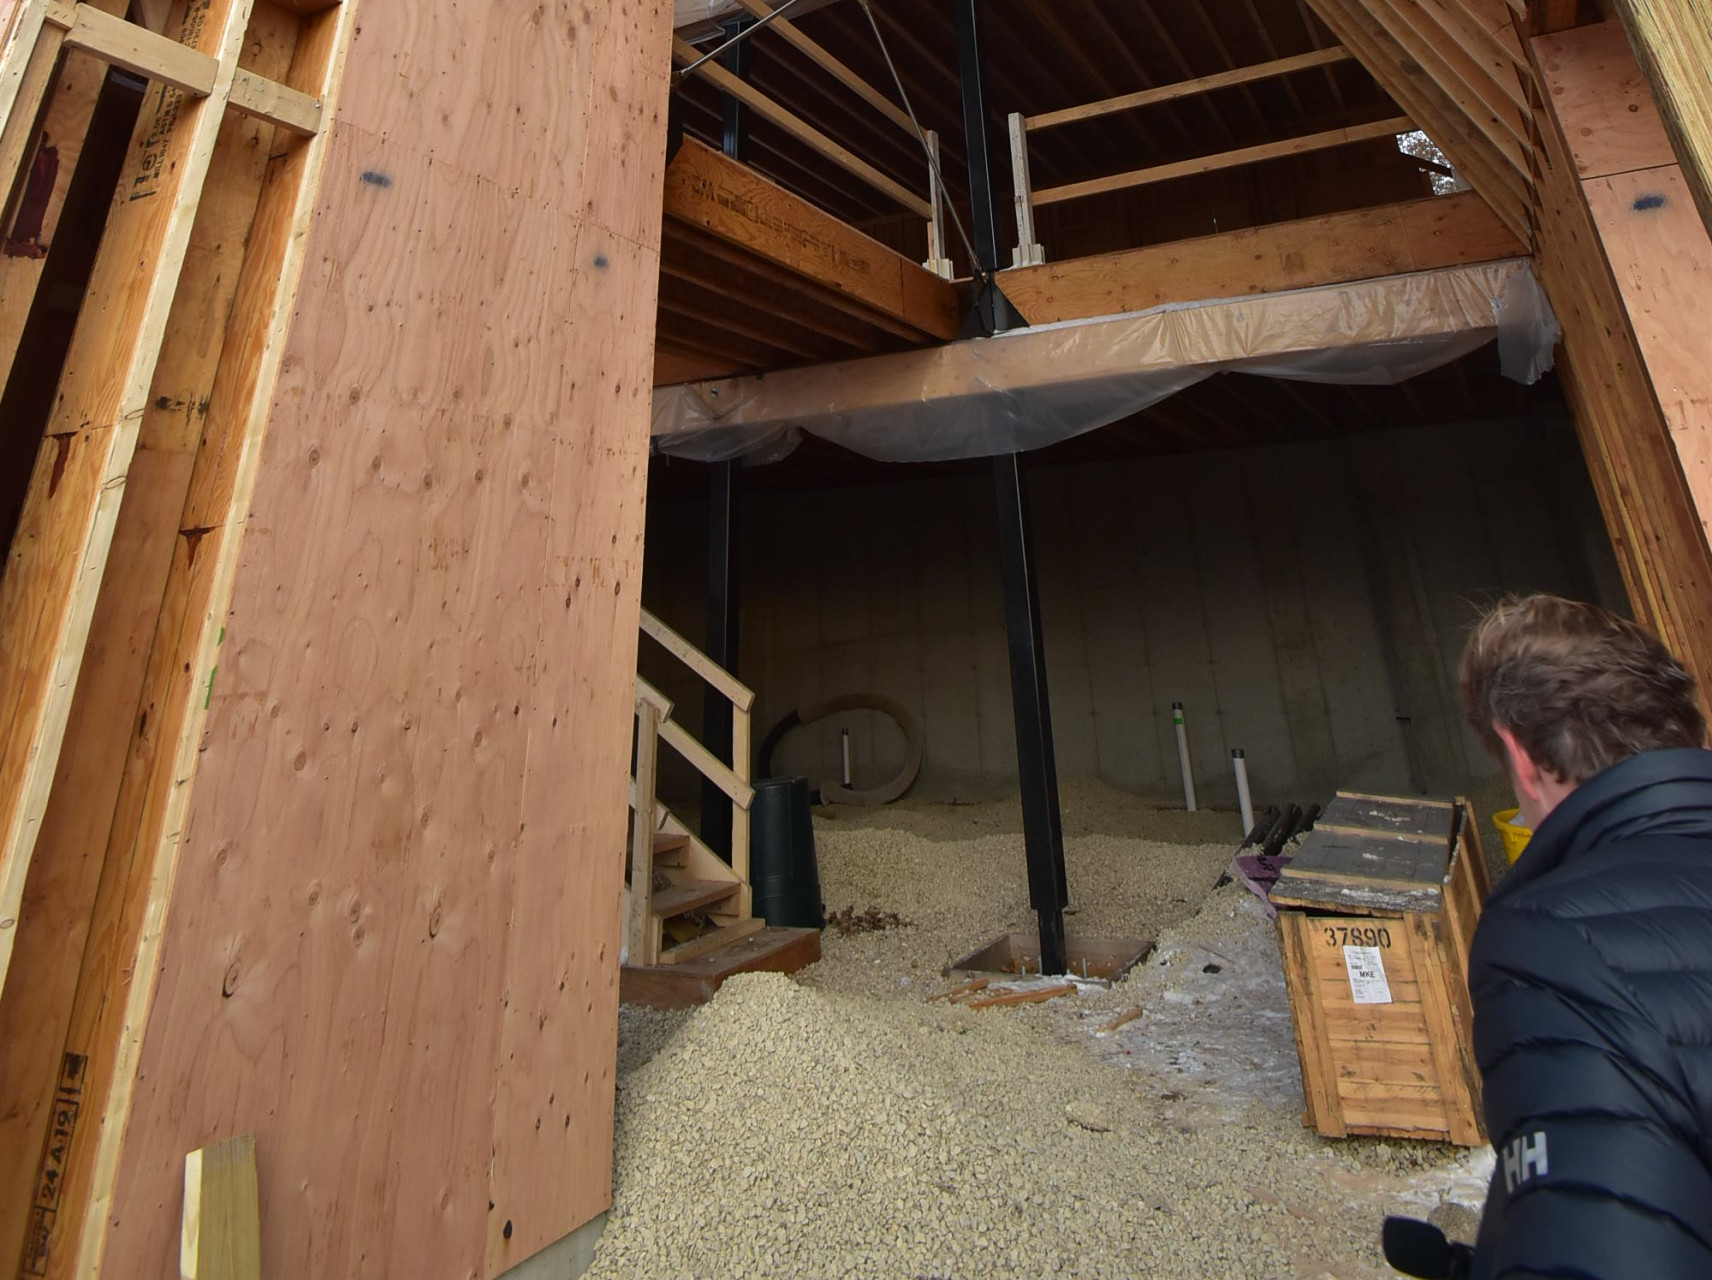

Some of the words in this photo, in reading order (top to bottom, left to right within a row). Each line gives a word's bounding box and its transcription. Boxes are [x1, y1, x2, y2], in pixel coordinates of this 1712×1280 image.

[1324, 927, 1391, 948] 37890
[1359, 970, 1375, 978] MKE
[1503, 1131, 1547, 1193] HH
